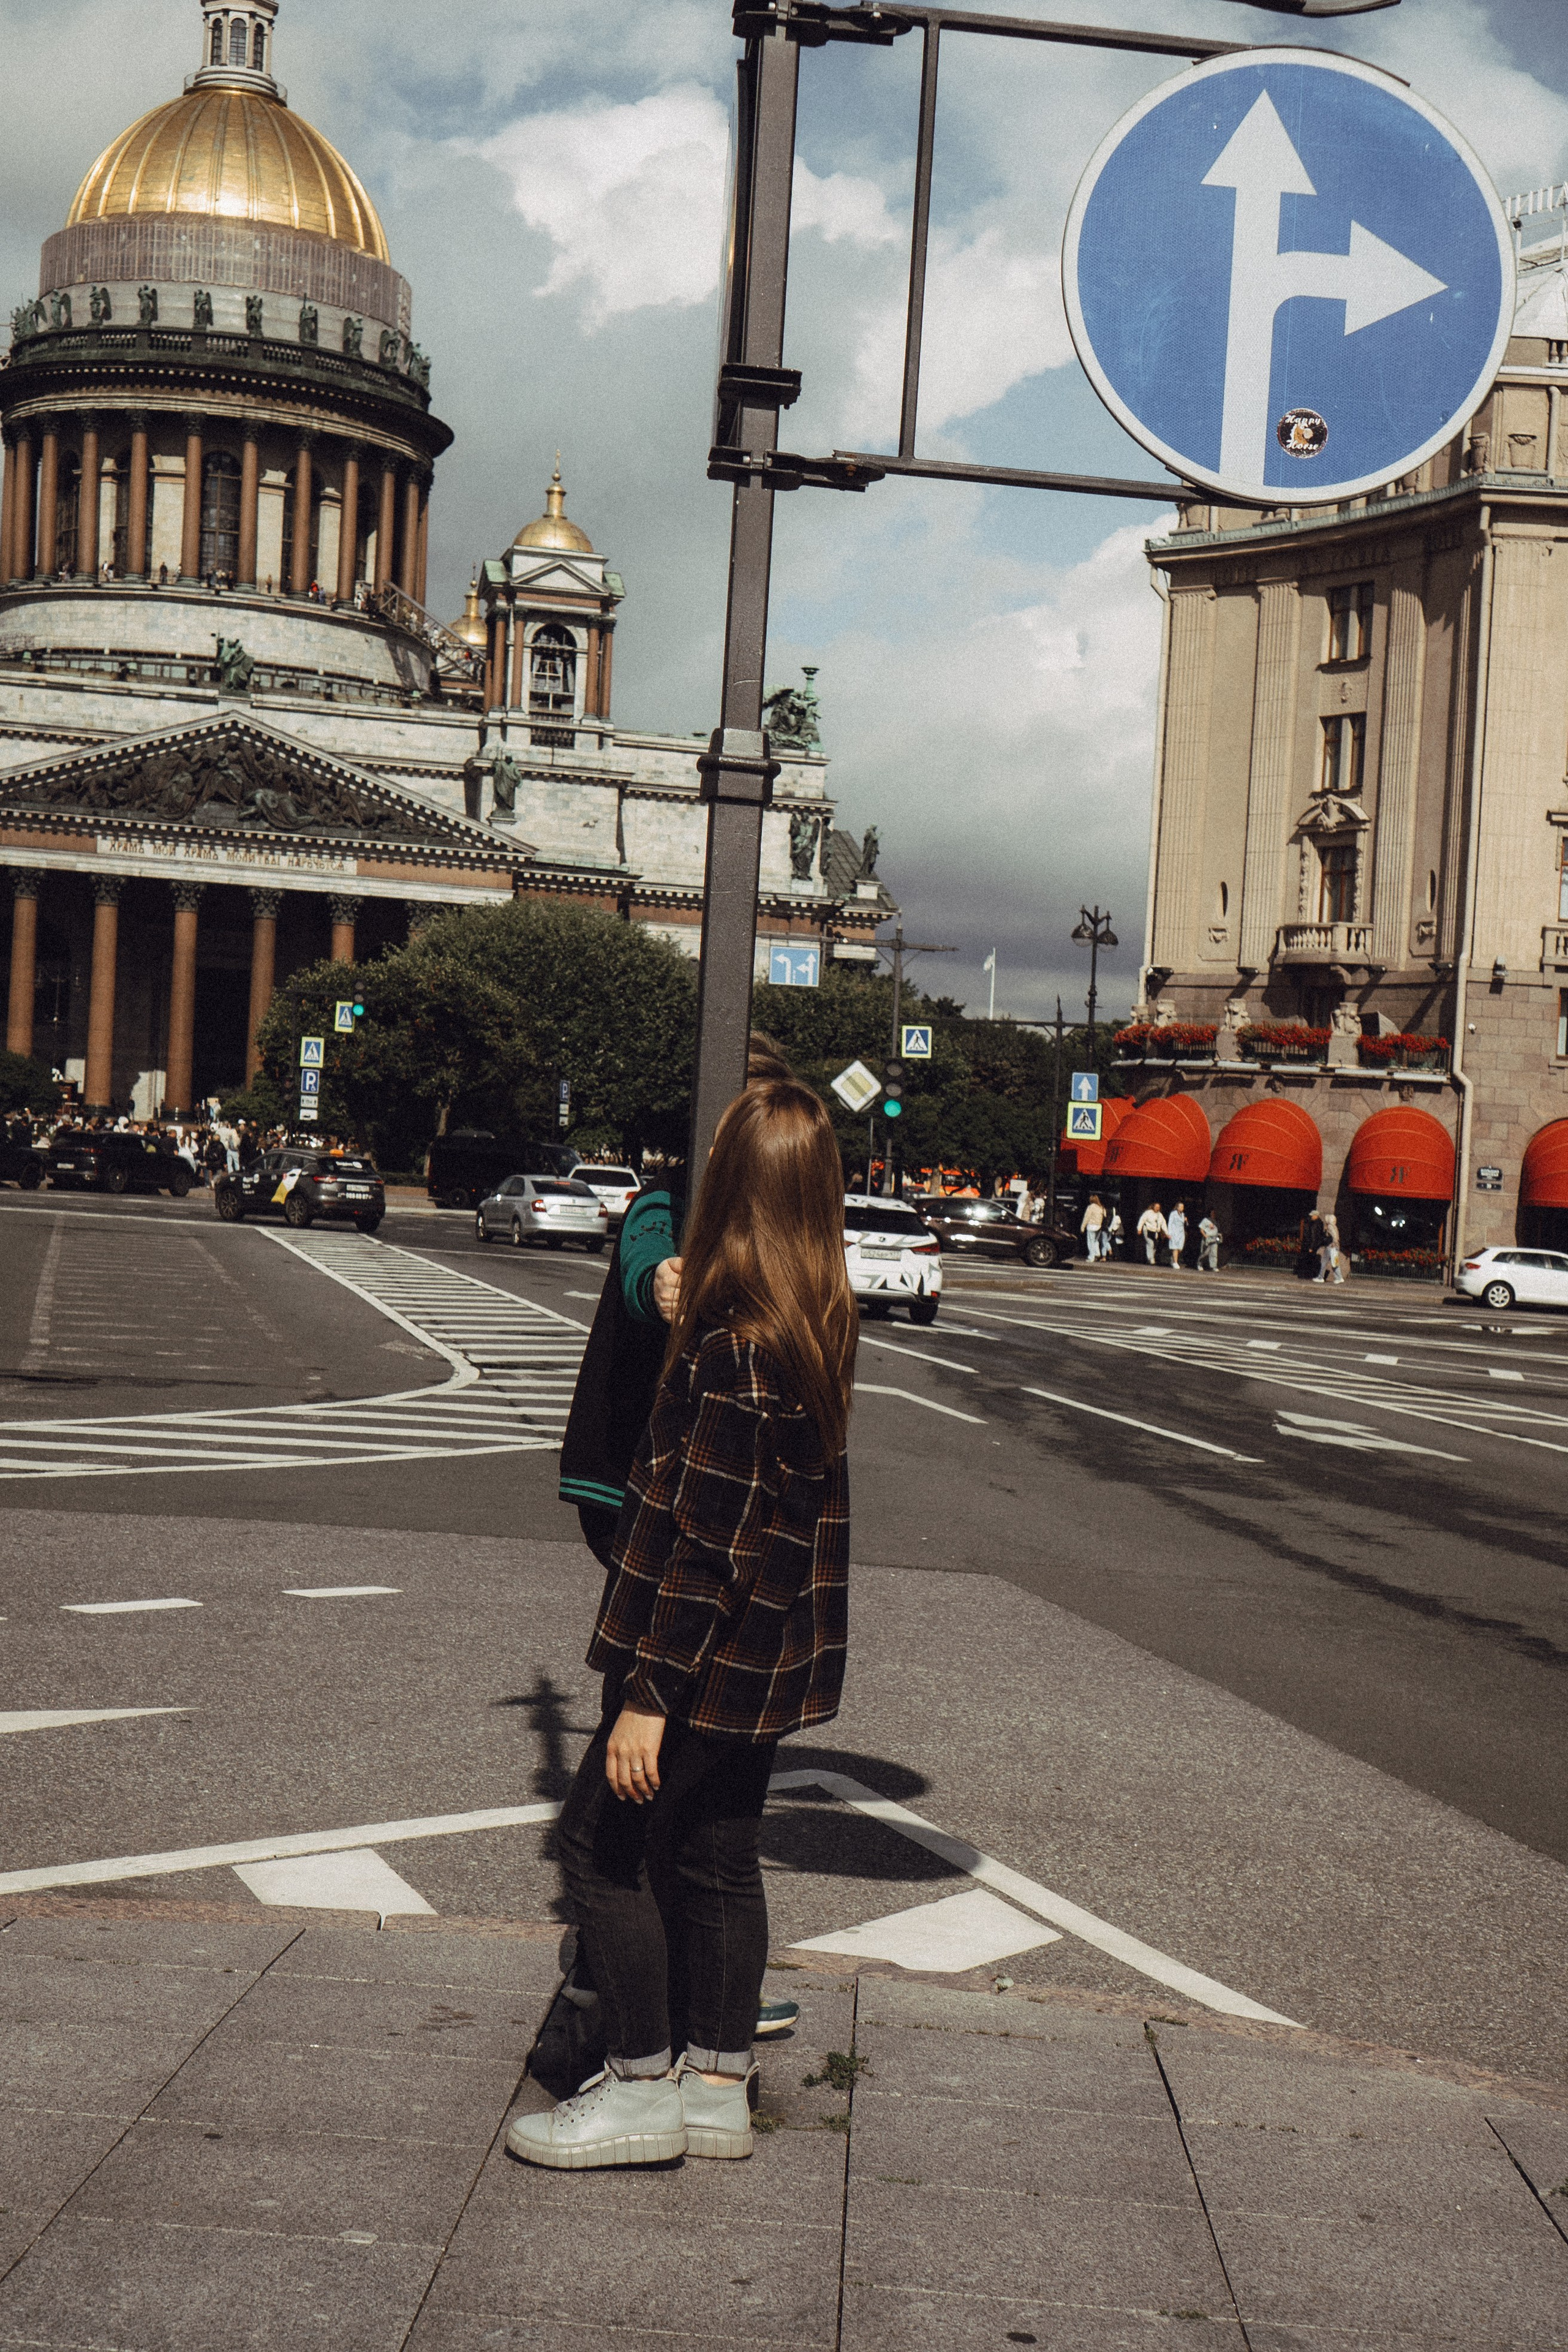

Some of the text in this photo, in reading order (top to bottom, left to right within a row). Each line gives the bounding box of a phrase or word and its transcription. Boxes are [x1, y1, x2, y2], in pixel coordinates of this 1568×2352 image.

[1285, 415, 1321, 426] Happy
[1286, 440, 1319, 450] Horse
[306, 1072, 316, 1090] P
